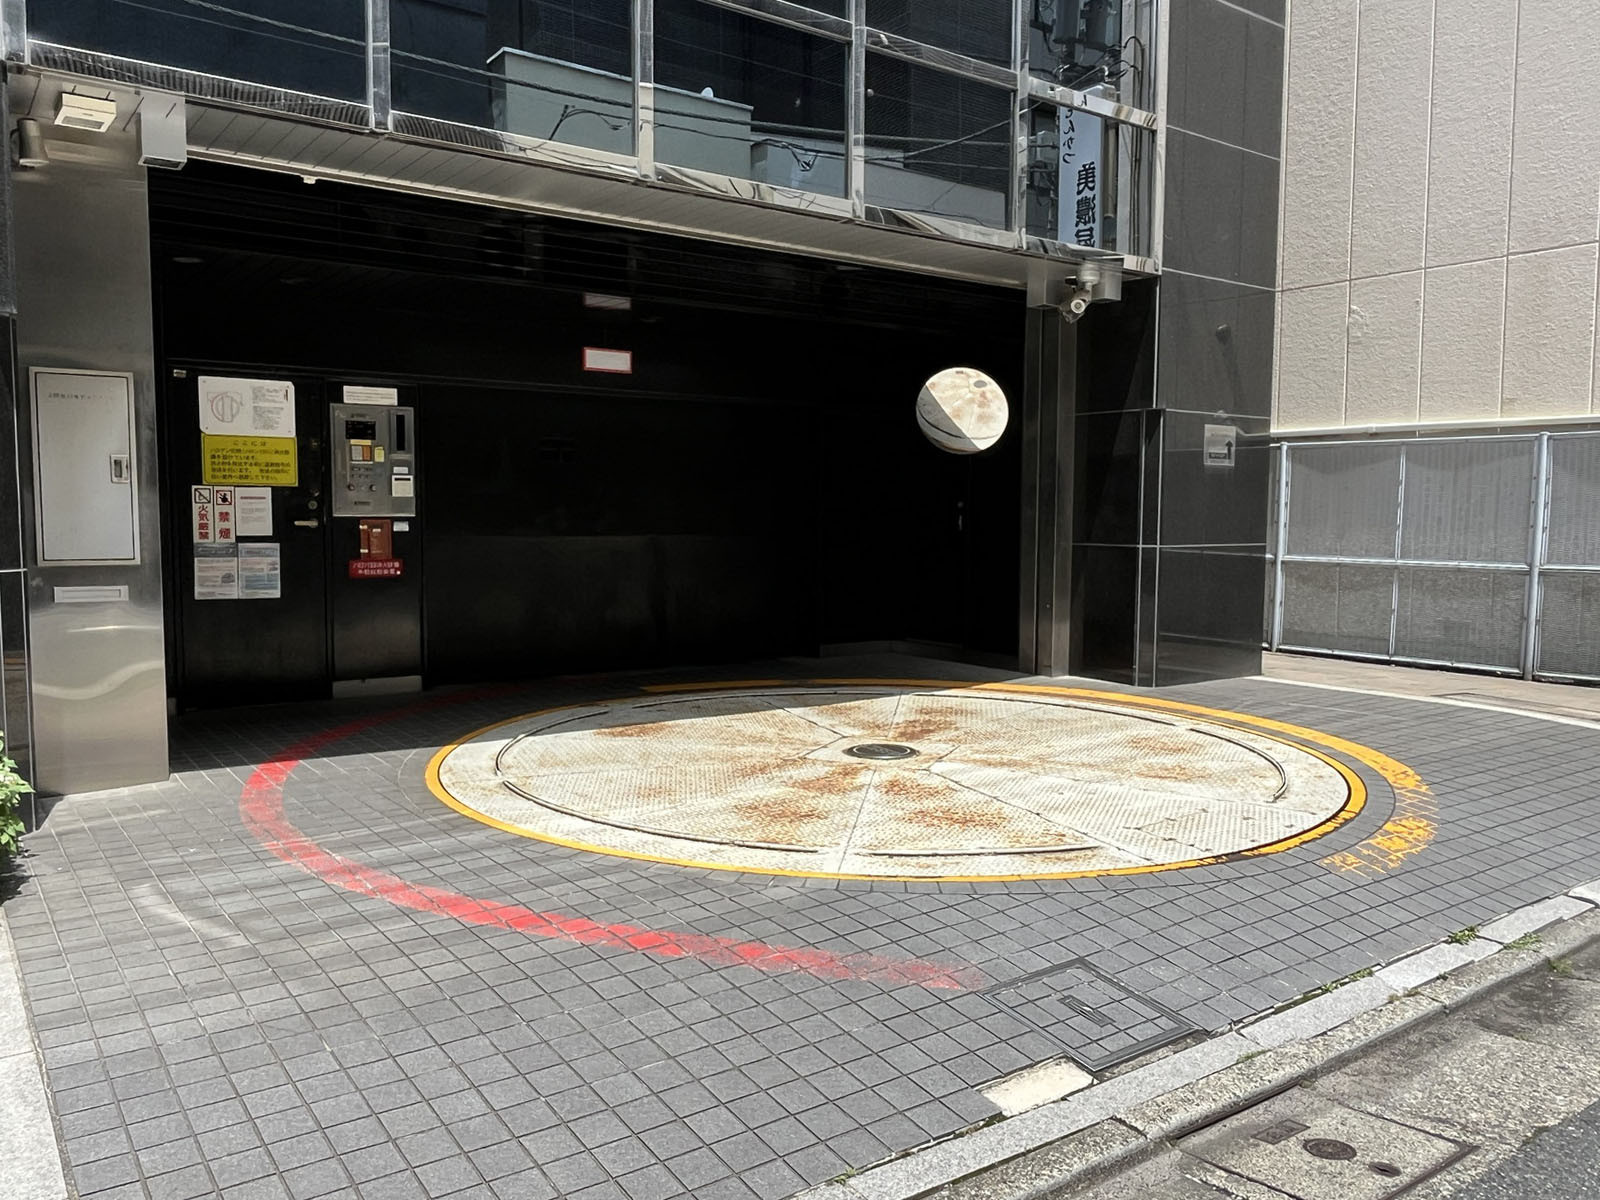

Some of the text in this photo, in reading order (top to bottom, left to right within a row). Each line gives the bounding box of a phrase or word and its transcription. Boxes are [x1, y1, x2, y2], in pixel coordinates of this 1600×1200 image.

[198, 504, 209, 540] 火気厳禁
[218, 511, 231, 539] 禁煙
